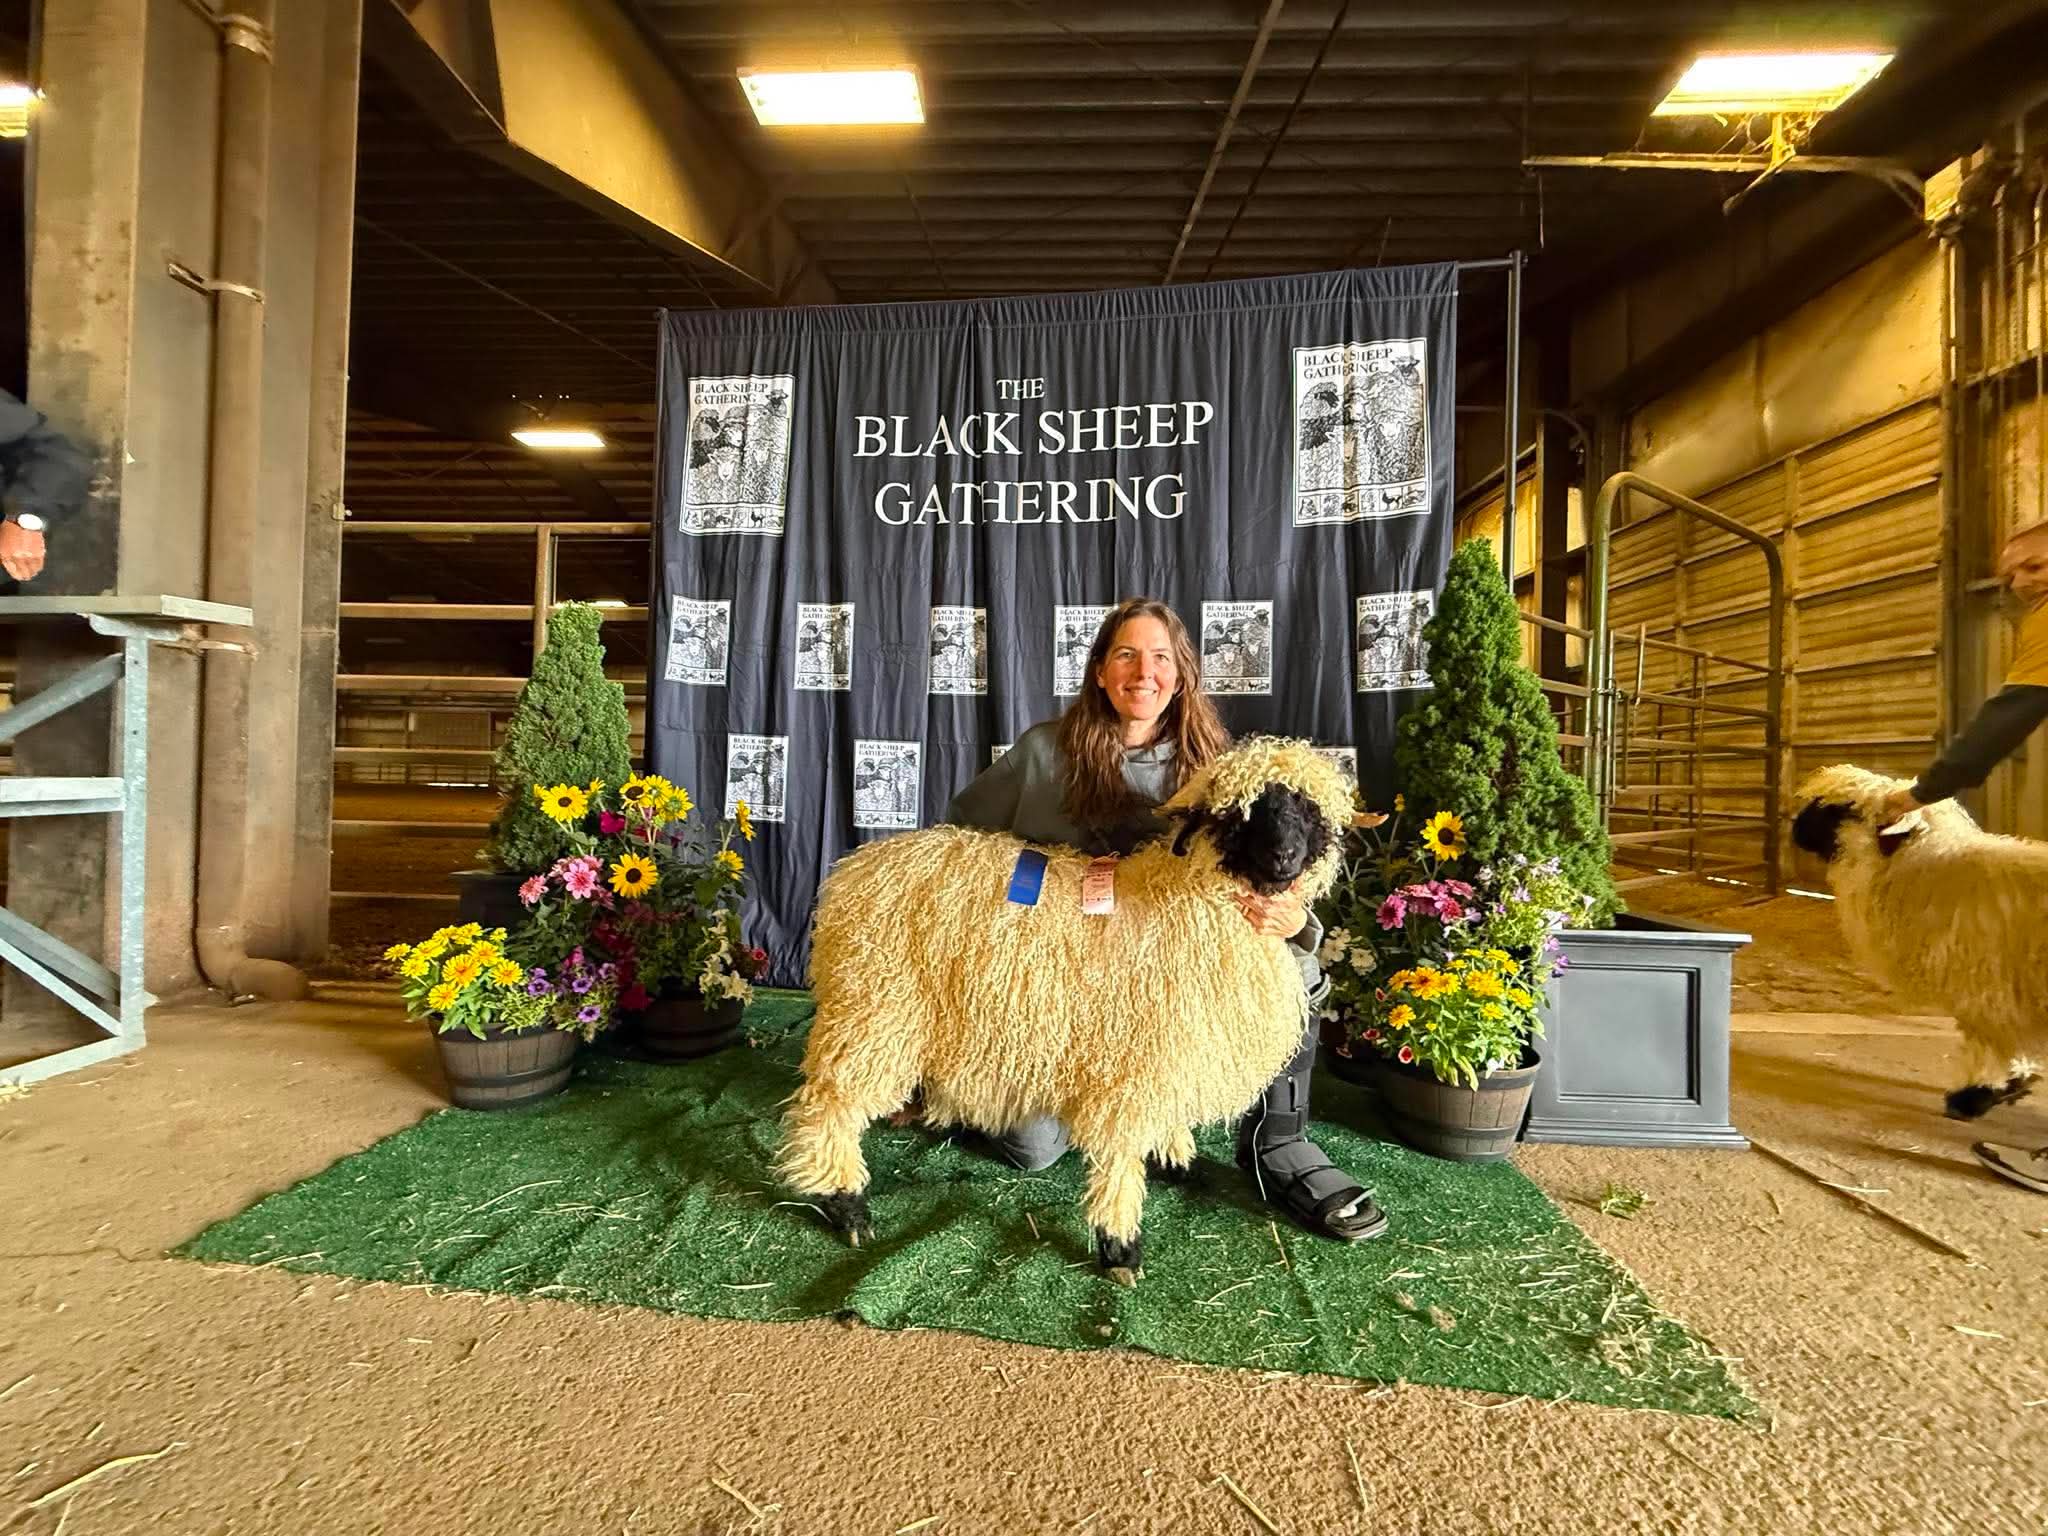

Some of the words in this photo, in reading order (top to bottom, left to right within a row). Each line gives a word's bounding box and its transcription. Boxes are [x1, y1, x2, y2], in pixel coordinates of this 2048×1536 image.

[1304, 351, 1347, 366] BLACK
[1350, 348, 1393, 361] SHEEP
[1304, 361, 1379, 379] GATHERING
[695, 384, 729, 394] BLACK
[733, 383, 768, 393] SHEEP
[996, 377, 1045, 400] THE
[694, 393, 757, 404] GATHERING
[853, 410, 1023, 458] BLACK
[1038, 401, 1214, 454] SHEEP
[875, 472, 1188, 526] GATHERING
